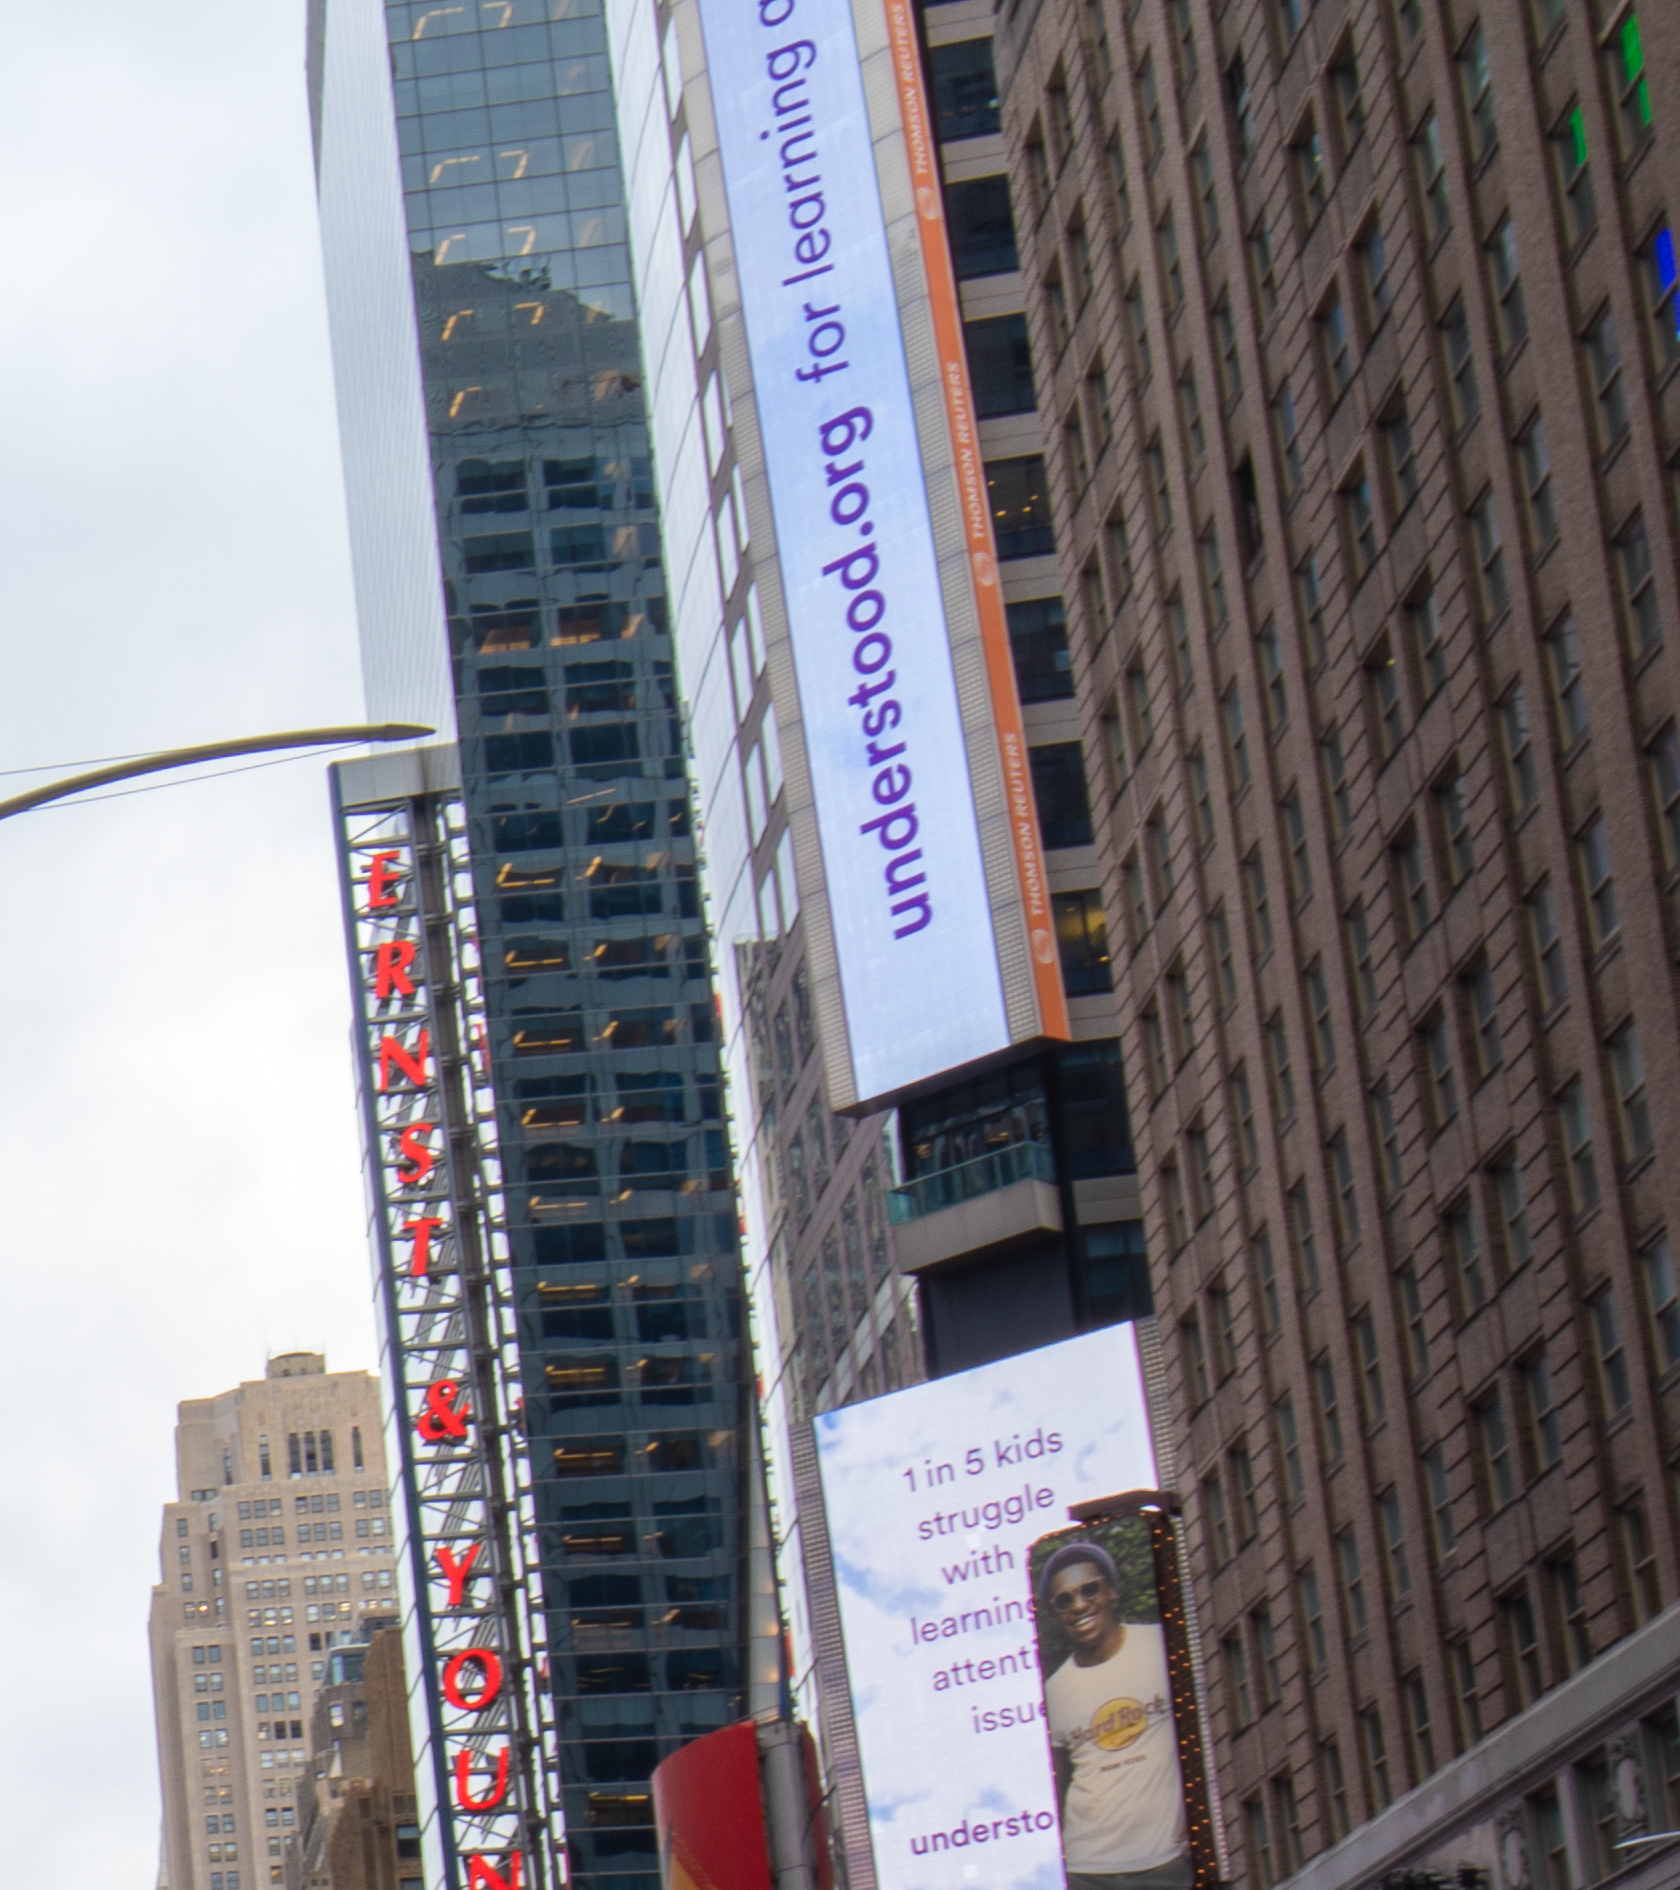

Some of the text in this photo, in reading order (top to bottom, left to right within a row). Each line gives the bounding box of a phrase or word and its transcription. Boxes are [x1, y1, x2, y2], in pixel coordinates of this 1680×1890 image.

[759, 32, 933, 941] understood.org for learning
[945, 360, 988, 541] THOMSON REUTERS
[1003, 730, 1051, 918] THOMSON REUTERS
[363, 848, 442, 1278] ERNST
[903, 1428, 1064, 1493] 1 in 5 kids
[917, 1484, 1056, 1542] struggle
[941, 1548, 1016, 1588] with
